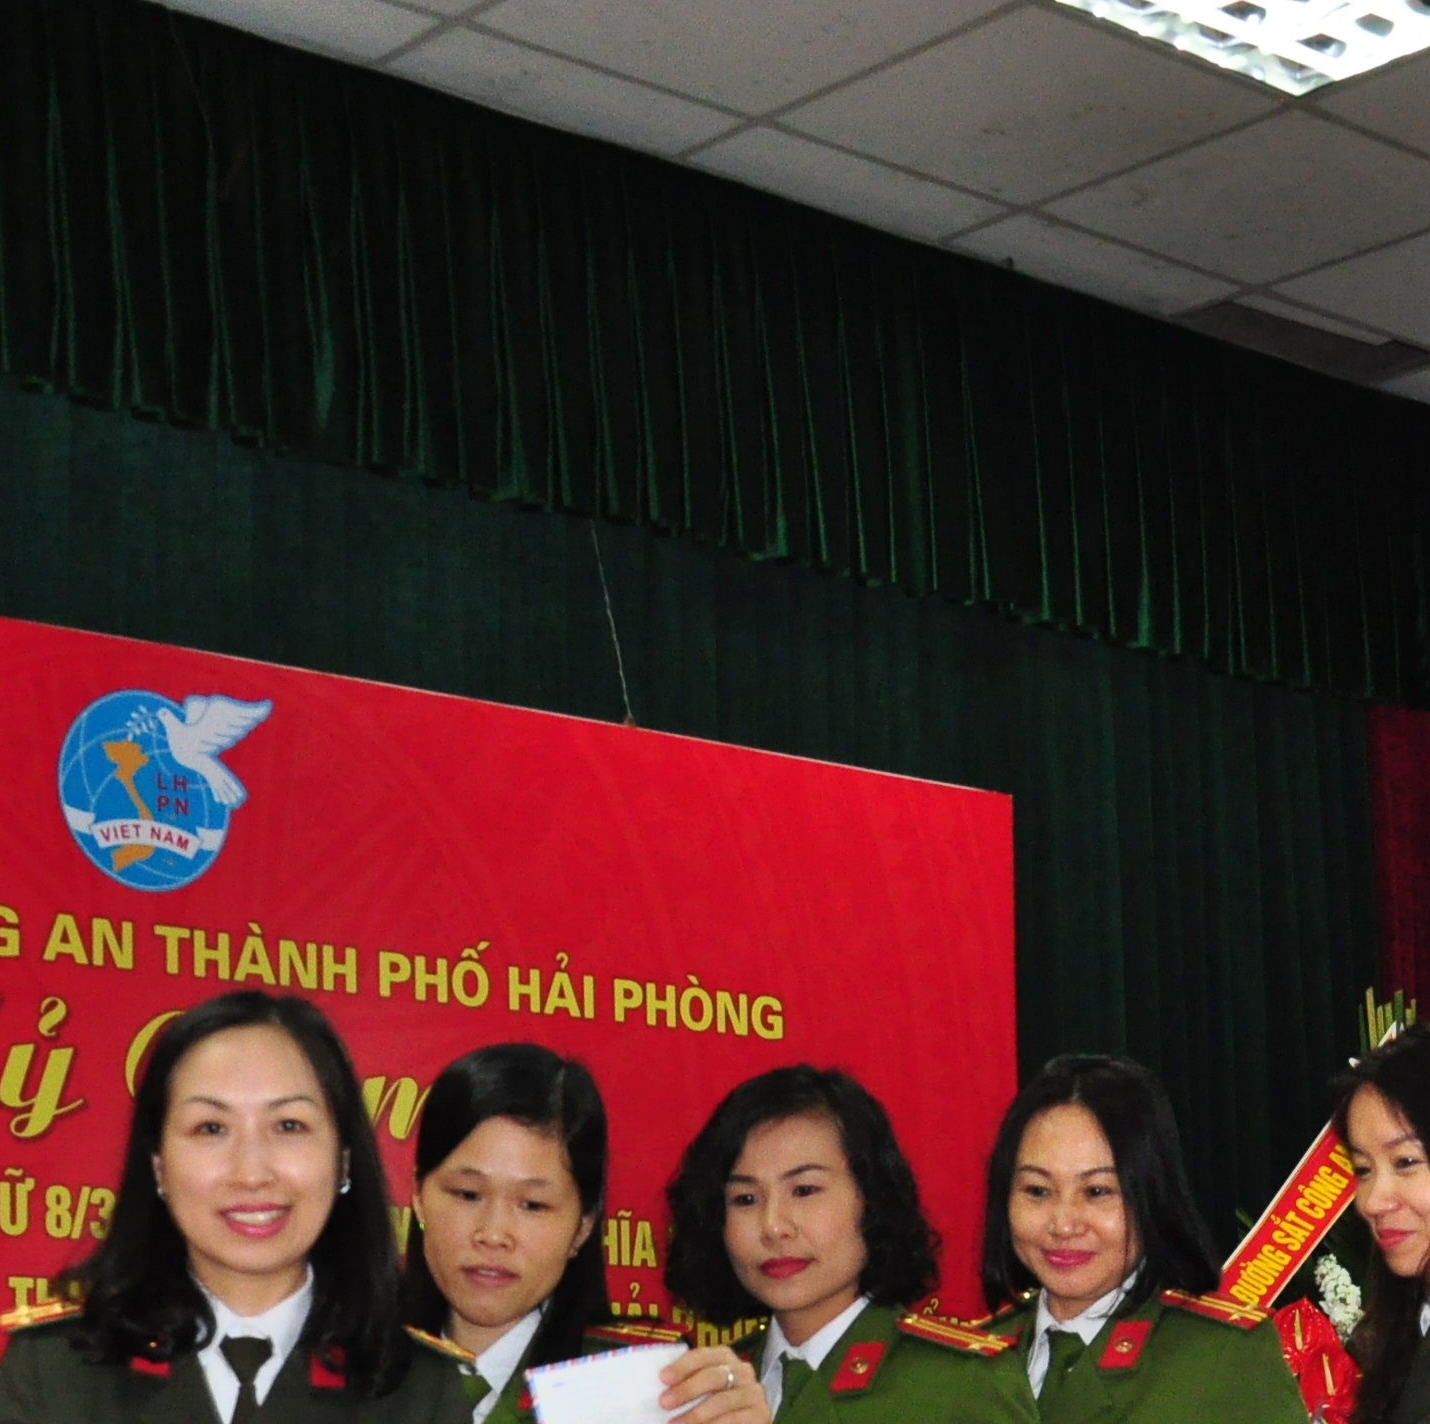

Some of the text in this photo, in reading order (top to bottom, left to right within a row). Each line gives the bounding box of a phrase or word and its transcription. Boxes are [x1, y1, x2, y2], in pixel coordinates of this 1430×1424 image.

[150, 826, 189, 850] NAM
[43, 914, 134, 969] AN
[154, 922, 358, 994] THÀNH
[379, 941, 489, 1008] PHỐ
[508, 952, 595, 1019] HẢI
[613, 975, 784, 1040] PHÒNG
[603, 1210, 657, 1267] HĨA
[1271, 1210, 1315, 1251] SẮT
[1295, 1165, 1350, 1220] CÔNG
